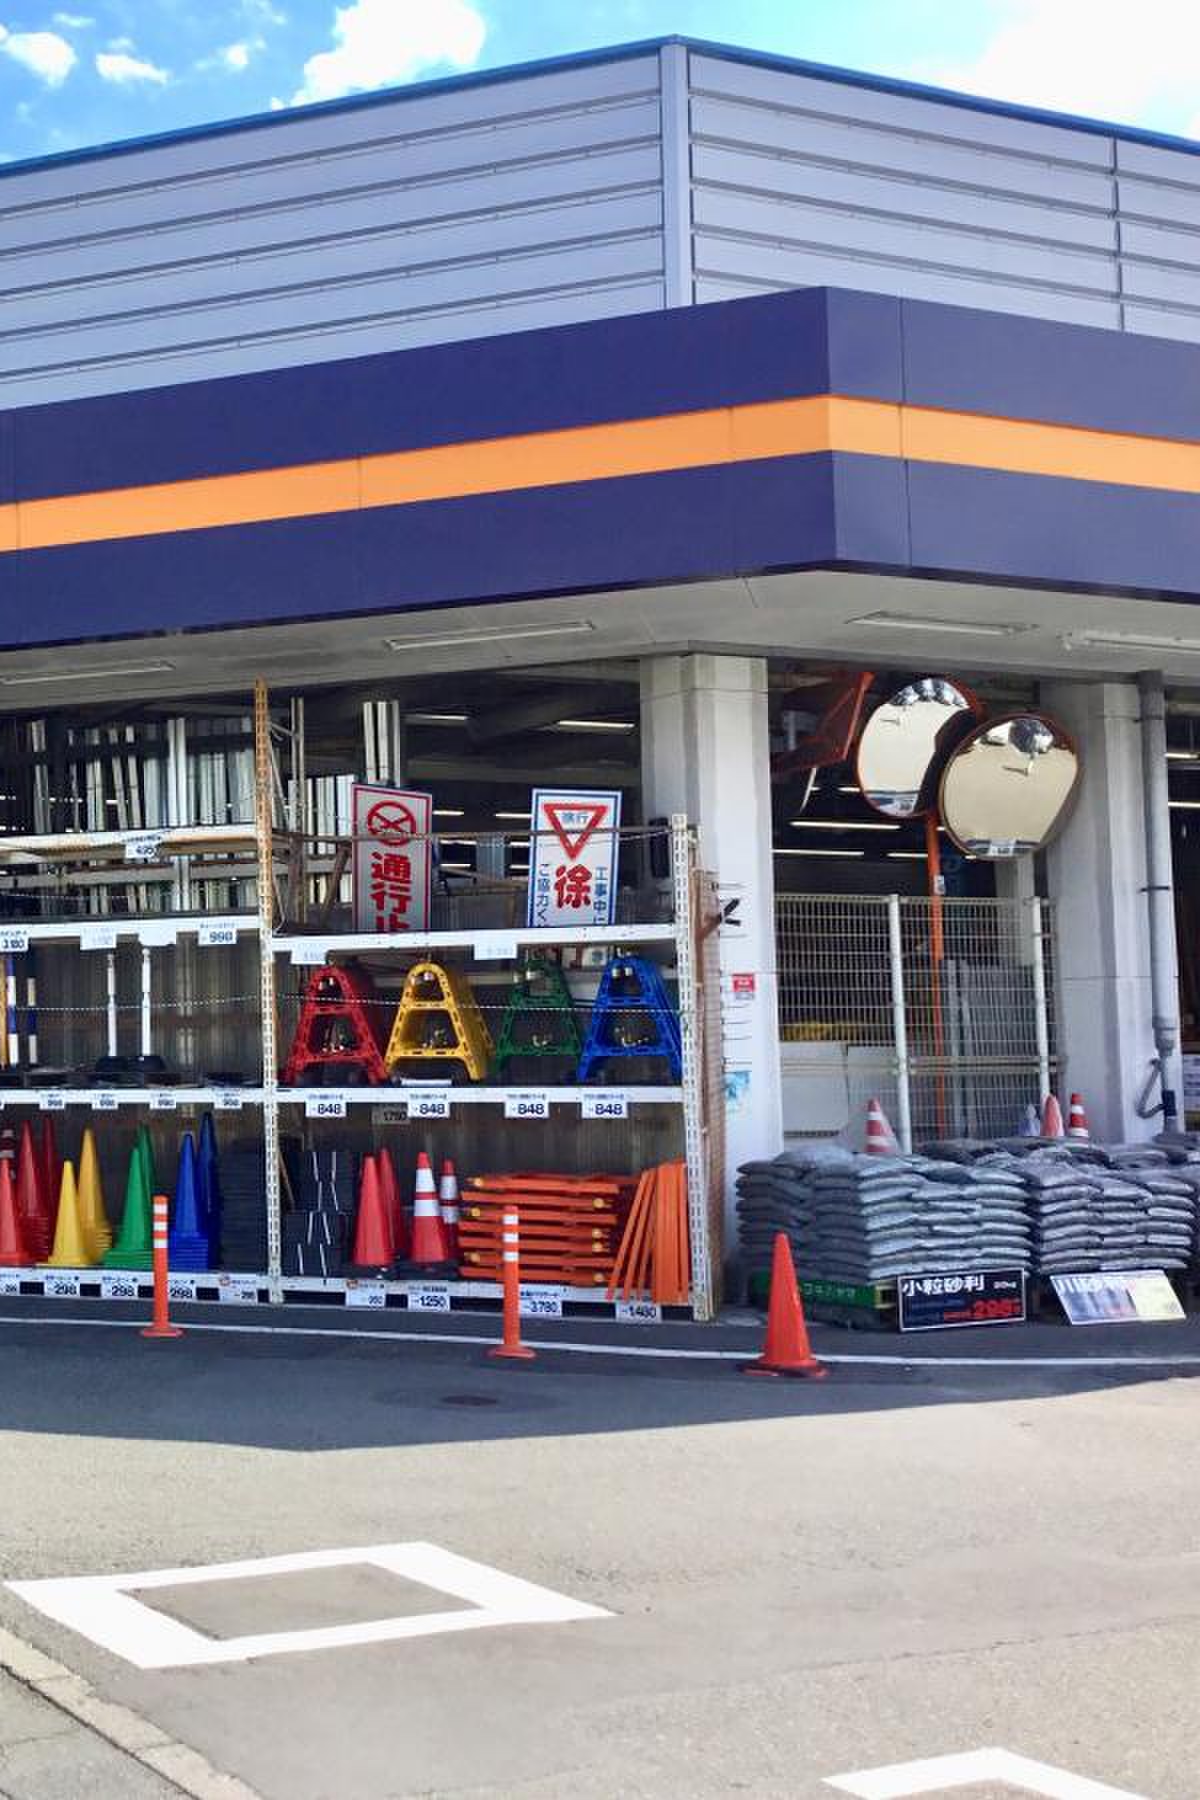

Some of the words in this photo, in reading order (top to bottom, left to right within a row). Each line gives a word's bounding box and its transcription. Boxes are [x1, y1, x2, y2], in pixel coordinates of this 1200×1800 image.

[536, 863, 551, 926] ご協力く
[419, 1103, 446, 1115] 848
[517, 1103, 545, 1115] 848
[595, 1103, 623, 1116] 848
[111, 1283, 135, 1297] 298
[901, 1274, 985, 1297] 小粒砂利
